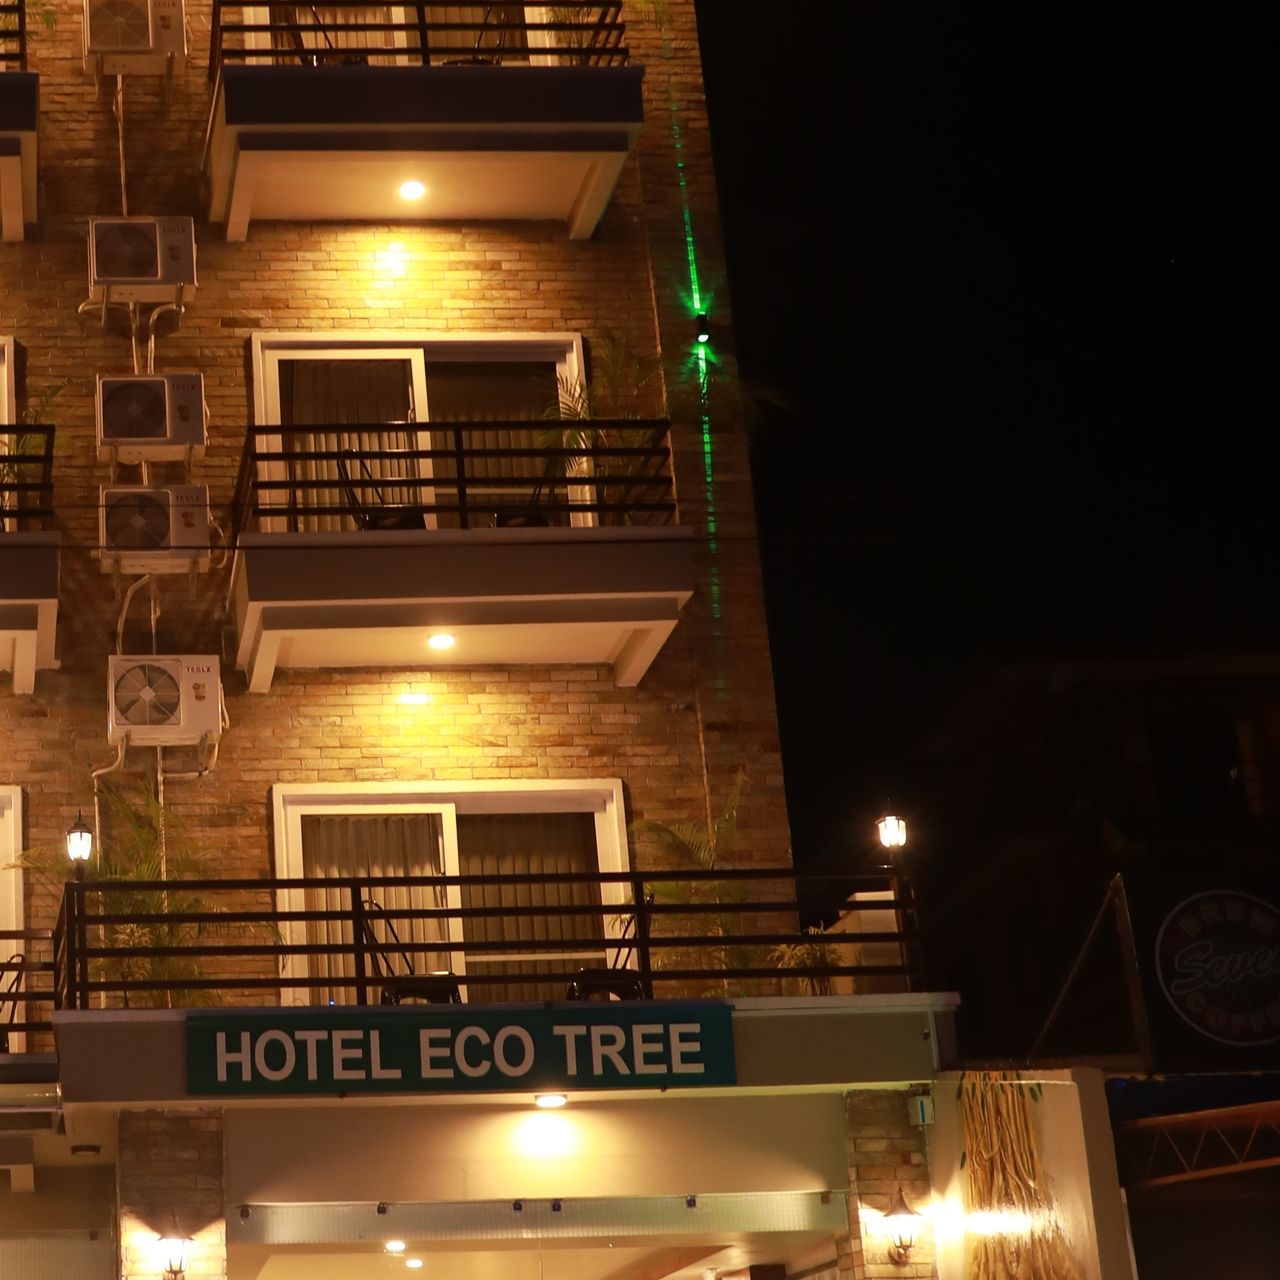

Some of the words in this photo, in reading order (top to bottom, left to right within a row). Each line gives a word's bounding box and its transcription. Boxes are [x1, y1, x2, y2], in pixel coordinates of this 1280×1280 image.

[217, 1029, 402, 1082] HOTEL
[420, 1026, 535, 1079] ECO
[553, 1023, 706, 1077] TREE
